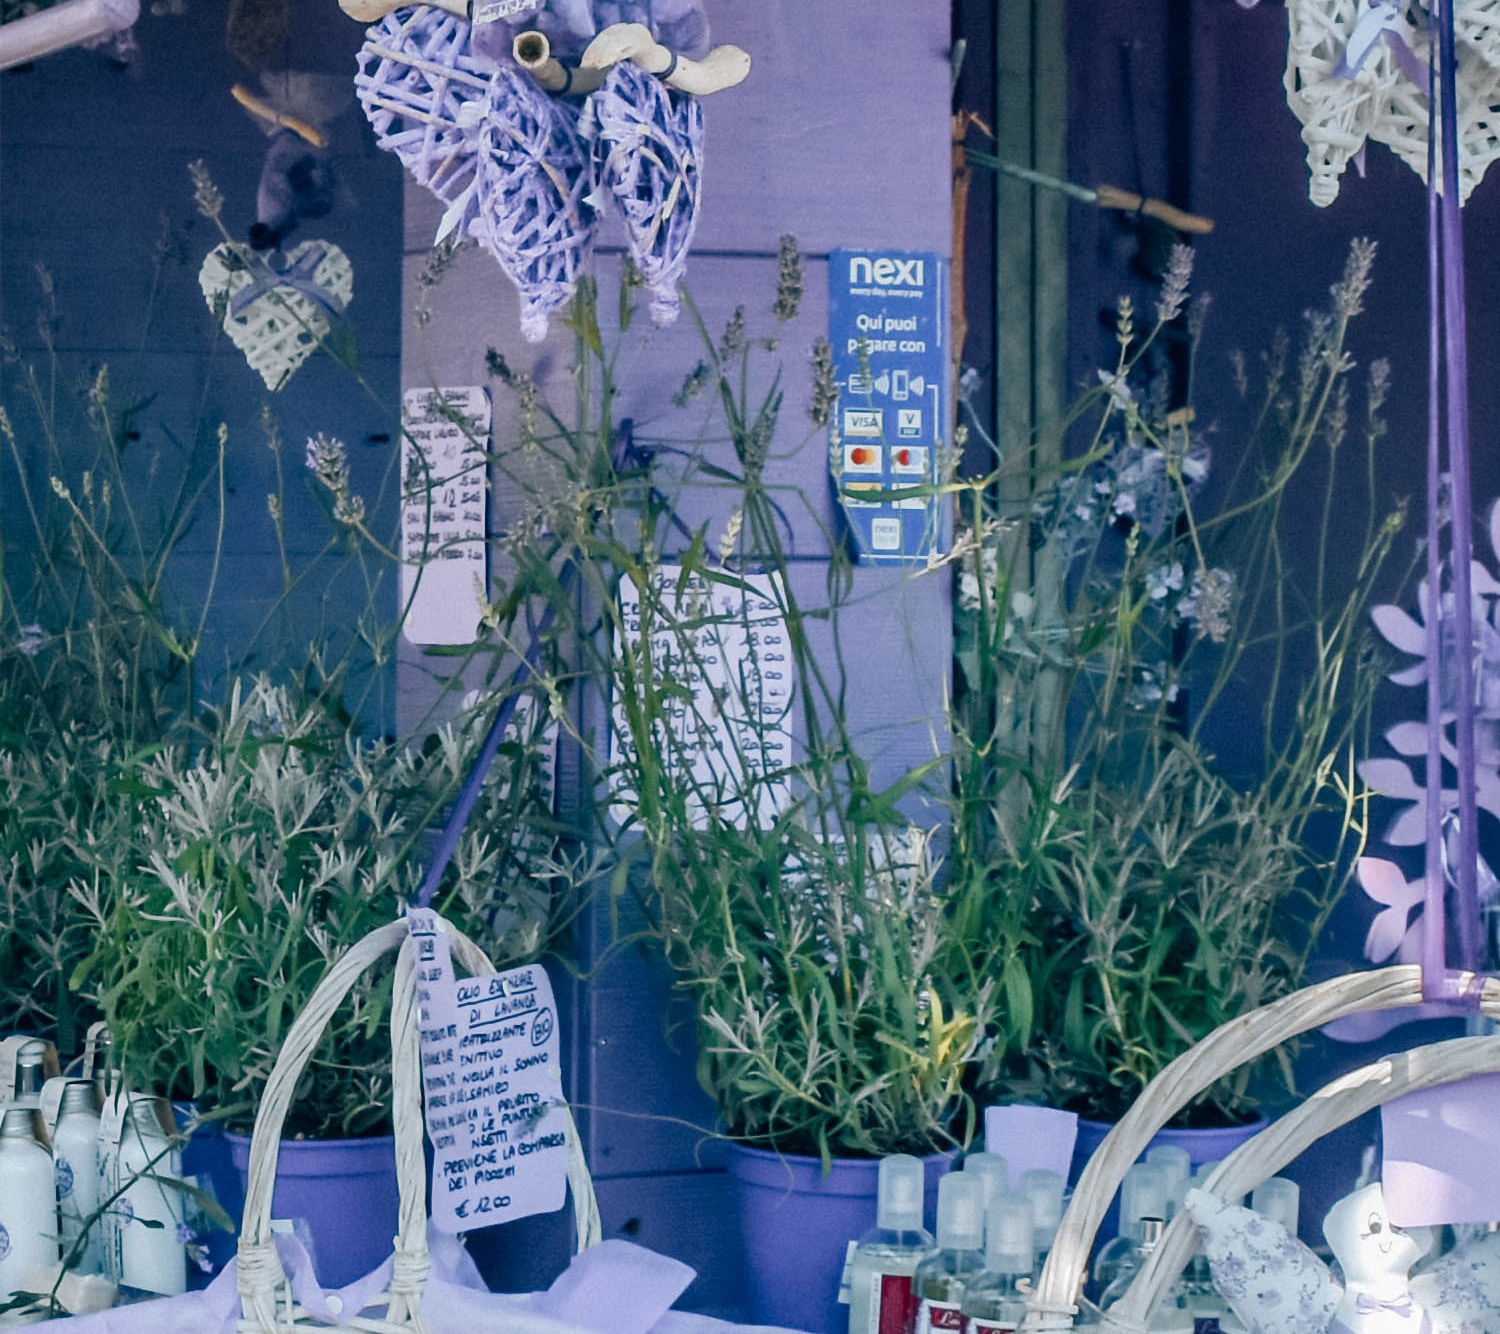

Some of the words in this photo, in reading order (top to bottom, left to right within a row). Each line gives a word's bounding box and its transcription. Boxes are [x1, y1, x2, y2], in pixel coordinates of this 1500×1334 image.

[850, 257, 924, 286] nexi
[856, 314, 882, 332] Qui
[885, 315, 917, 334] puoi
[848, 339, 896, 354] pgare
[899, 340, 926, 352] con
[852, 417, 878, 427] VISA
[457, 986, 480, 1002] OLIO
[489, 971, 533, 995] ESSNZIALE
[470, 1009, 480, 1022] DI
[514, 1052, 549, 1072] SONNO
[472, 1130, 507, 1148] NSETTI
[503, 1145, 515, 1160] LA
